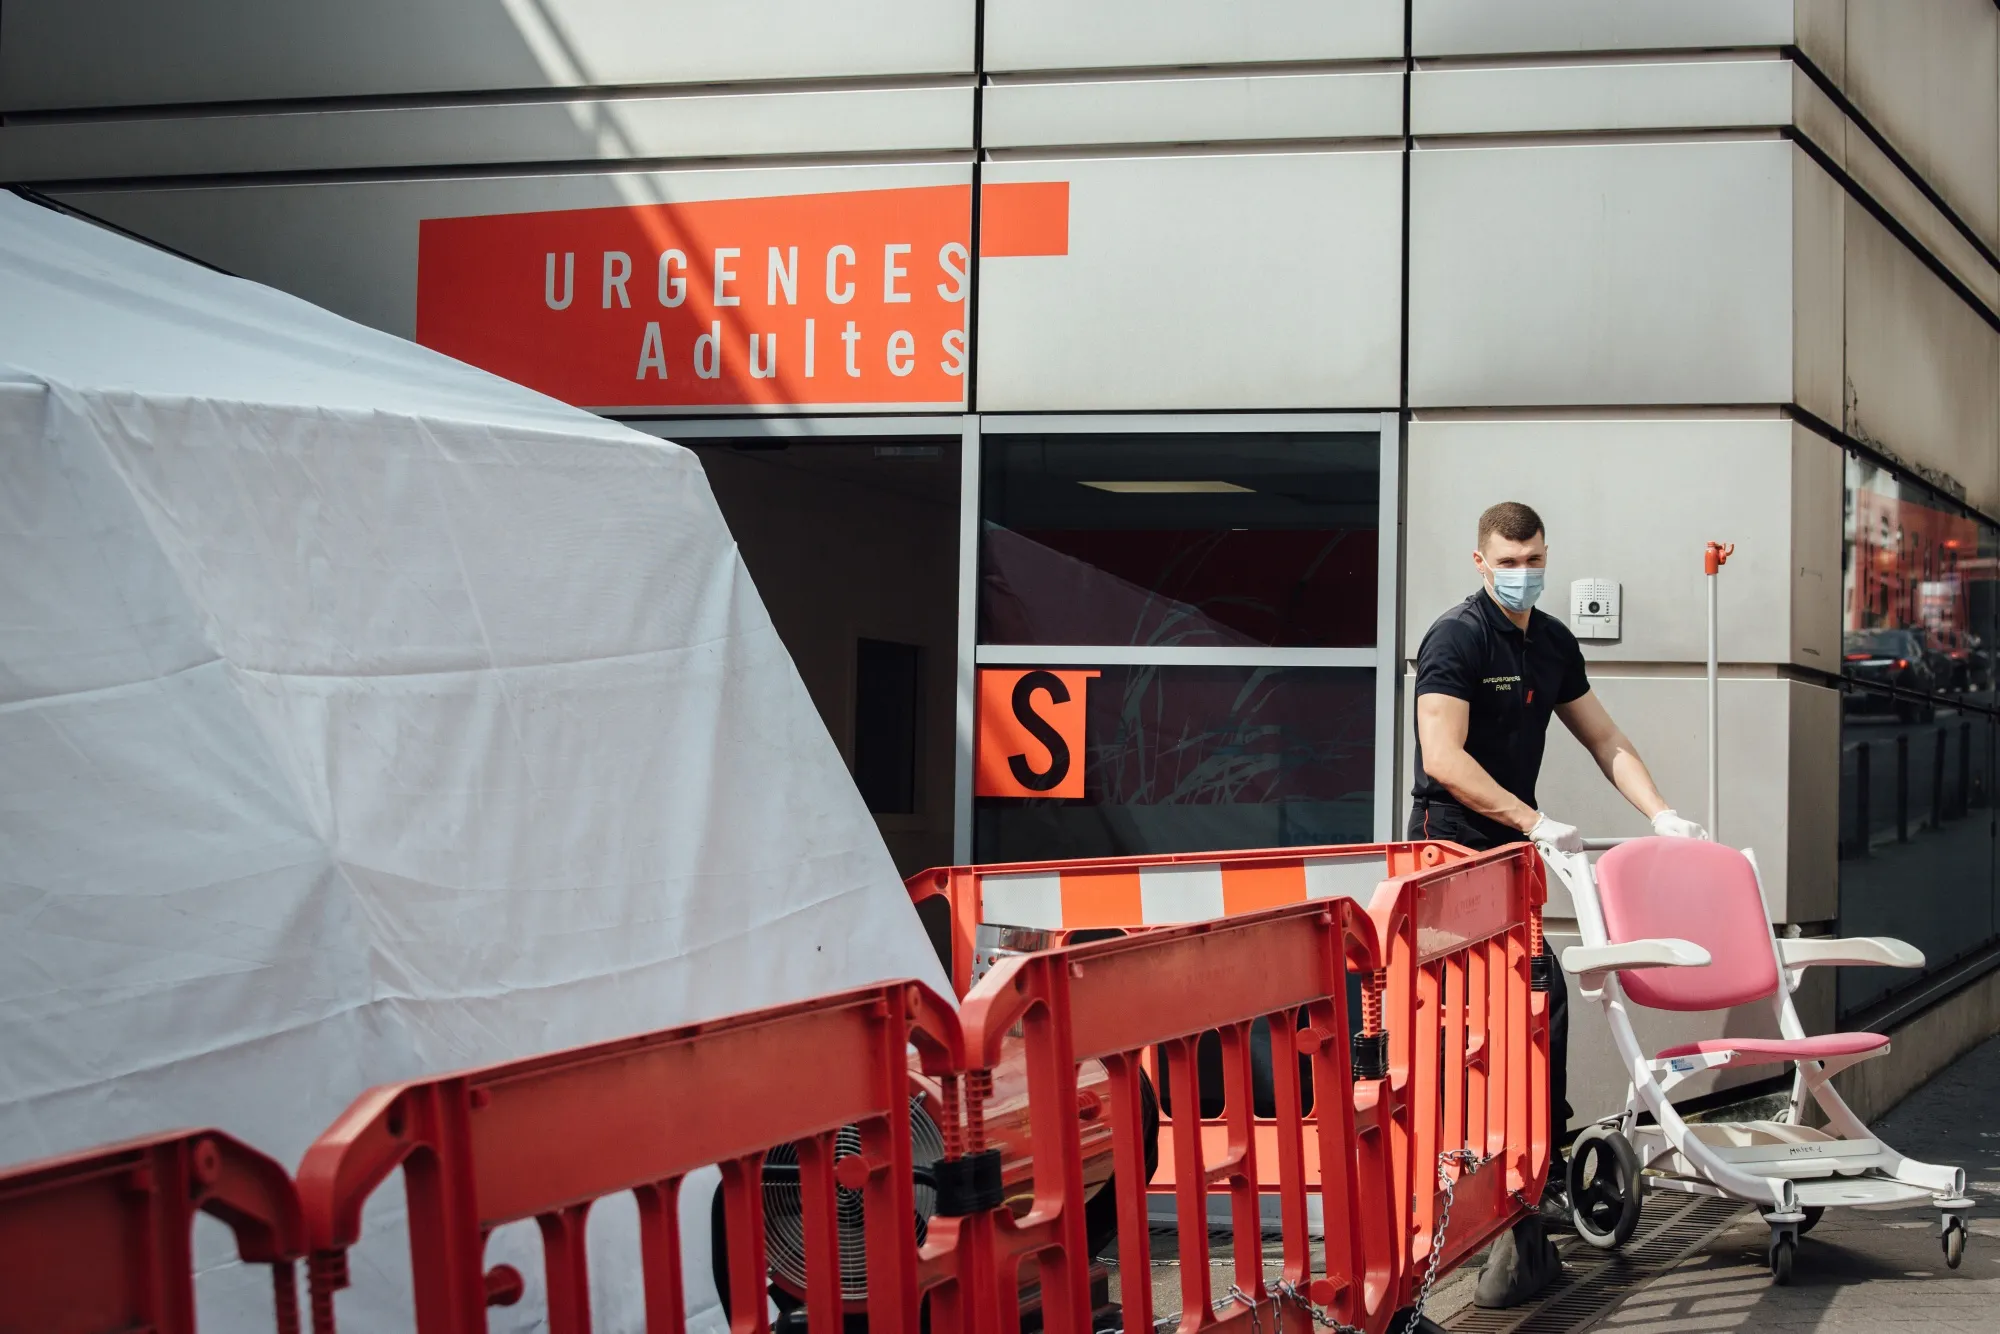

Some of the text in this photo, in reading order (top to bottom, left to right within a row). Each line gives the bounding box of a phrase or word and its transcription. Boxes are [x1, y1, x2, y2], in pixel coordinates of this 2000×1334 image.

[545, 242, 969, 310] URGENCES
[636, 318, 966, 380] Adultes
[1495, 683, 1512, 691] PARIS
[1008, 670, 1071, 792] S
